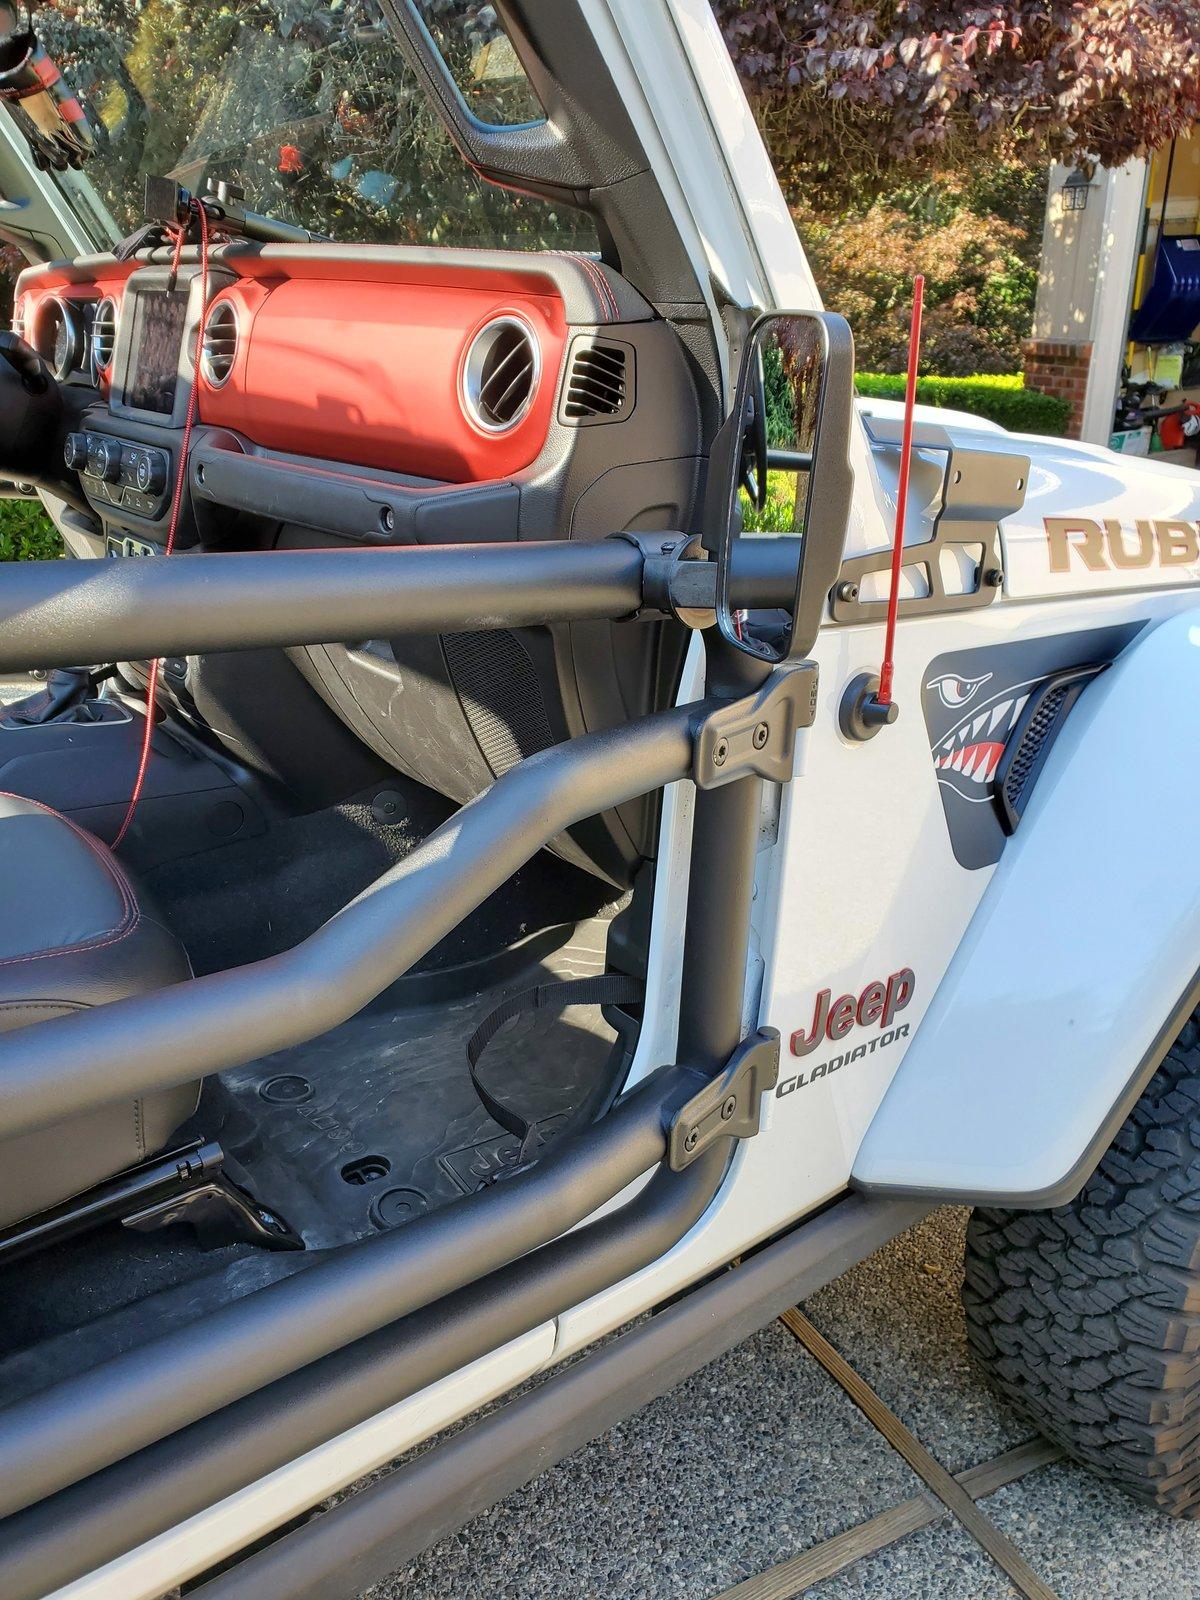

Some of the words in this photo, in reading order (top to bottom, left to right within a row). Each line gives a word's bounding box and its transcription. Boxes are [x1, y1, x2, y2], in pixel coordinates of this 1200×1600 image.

[1043, 517, 1200, 573] RUB
[789, 967, 916, 1057] Jeep
[775, 1023, 910, 1099] GLADIATOR
